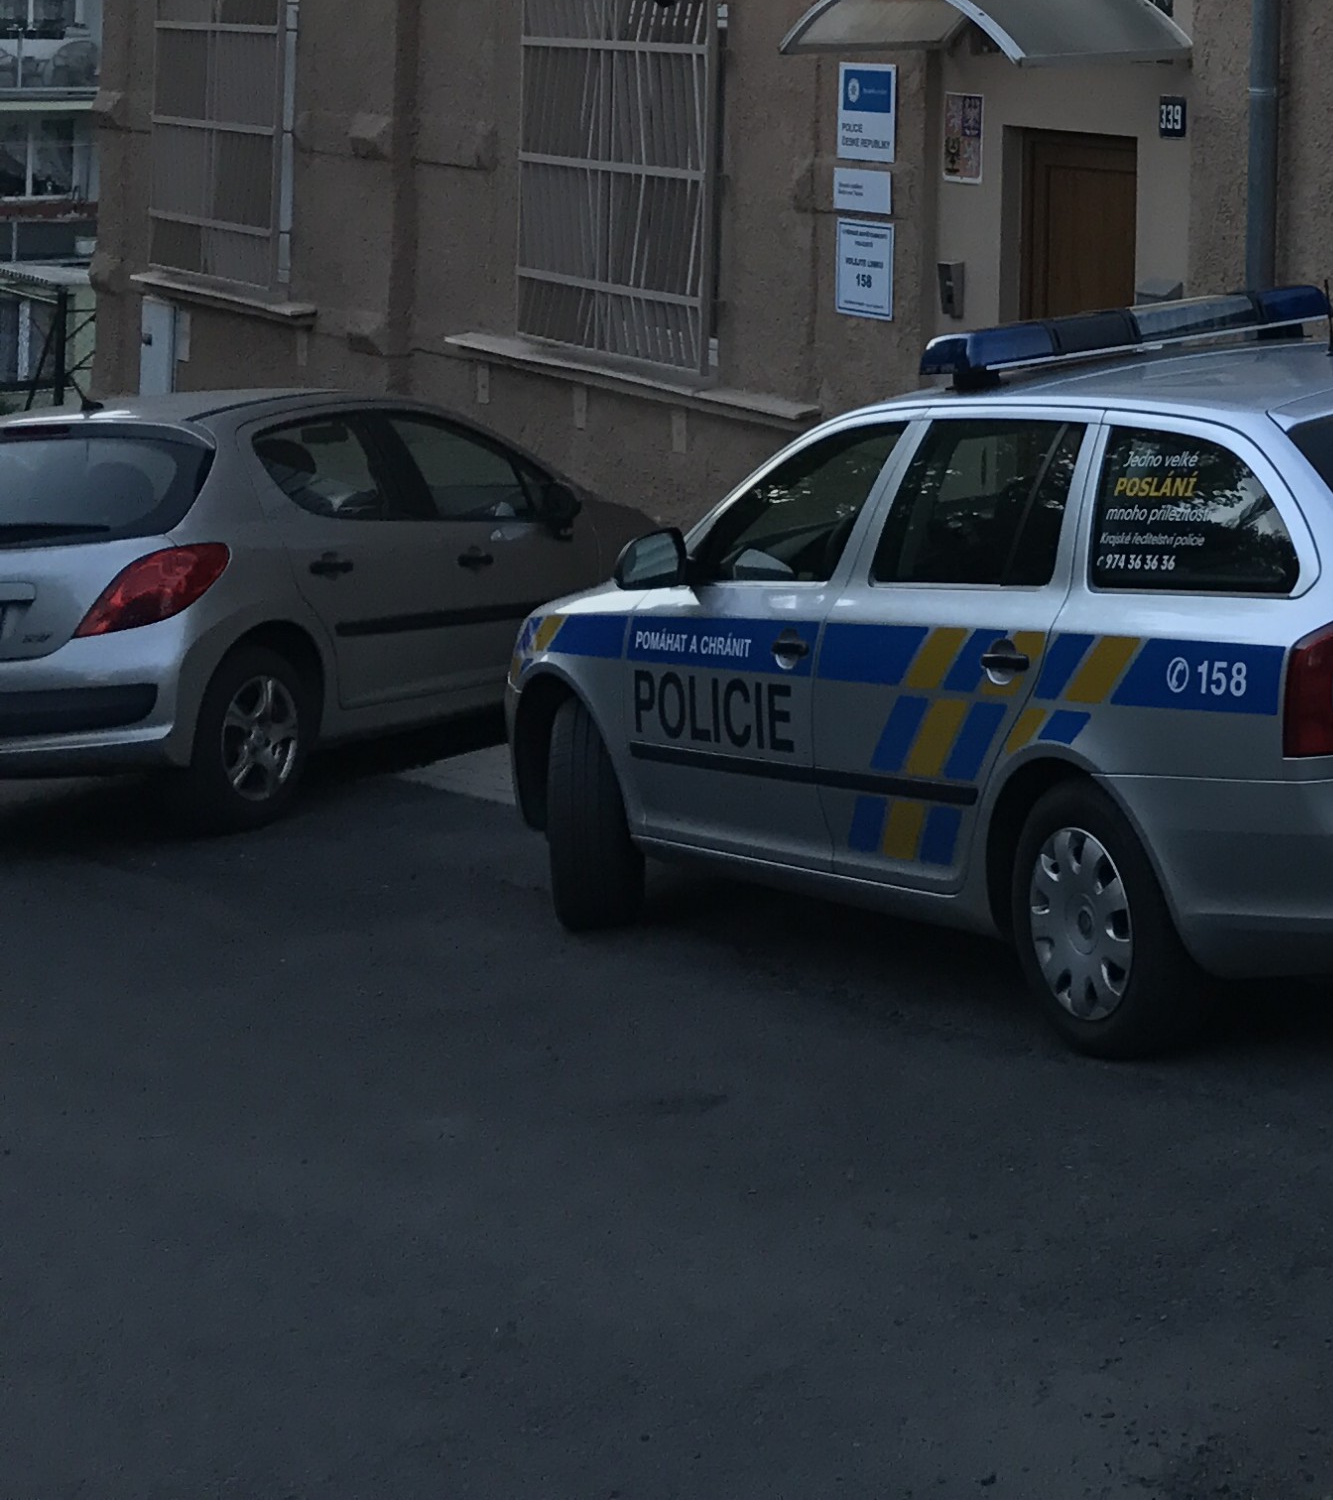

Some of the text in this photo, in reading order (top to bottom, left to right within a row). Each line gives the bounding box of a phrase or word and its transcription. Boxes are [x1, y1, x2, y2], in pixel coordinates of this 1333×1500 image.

[1160, 104, 1182, 130] 339
[855, 272, 873, 289] 158
[1123, 450, 1199, 468] Jedno velké
[1114, 470, 1199, 497] POSLÁNÍ
[1105, 504, 1148, 521] mnoho
[1100, 532, 1132, 547] Krajské
[1173, 533, 1206, 548] policie
[1105, 554, 1176, 570] 974 36 36 36
[635, 628, 752, 658] POMÁHAT A CHRÁNIT
[1197, 660, 1248, 697] 158
[634, 669, 795, 753] POLICIE
